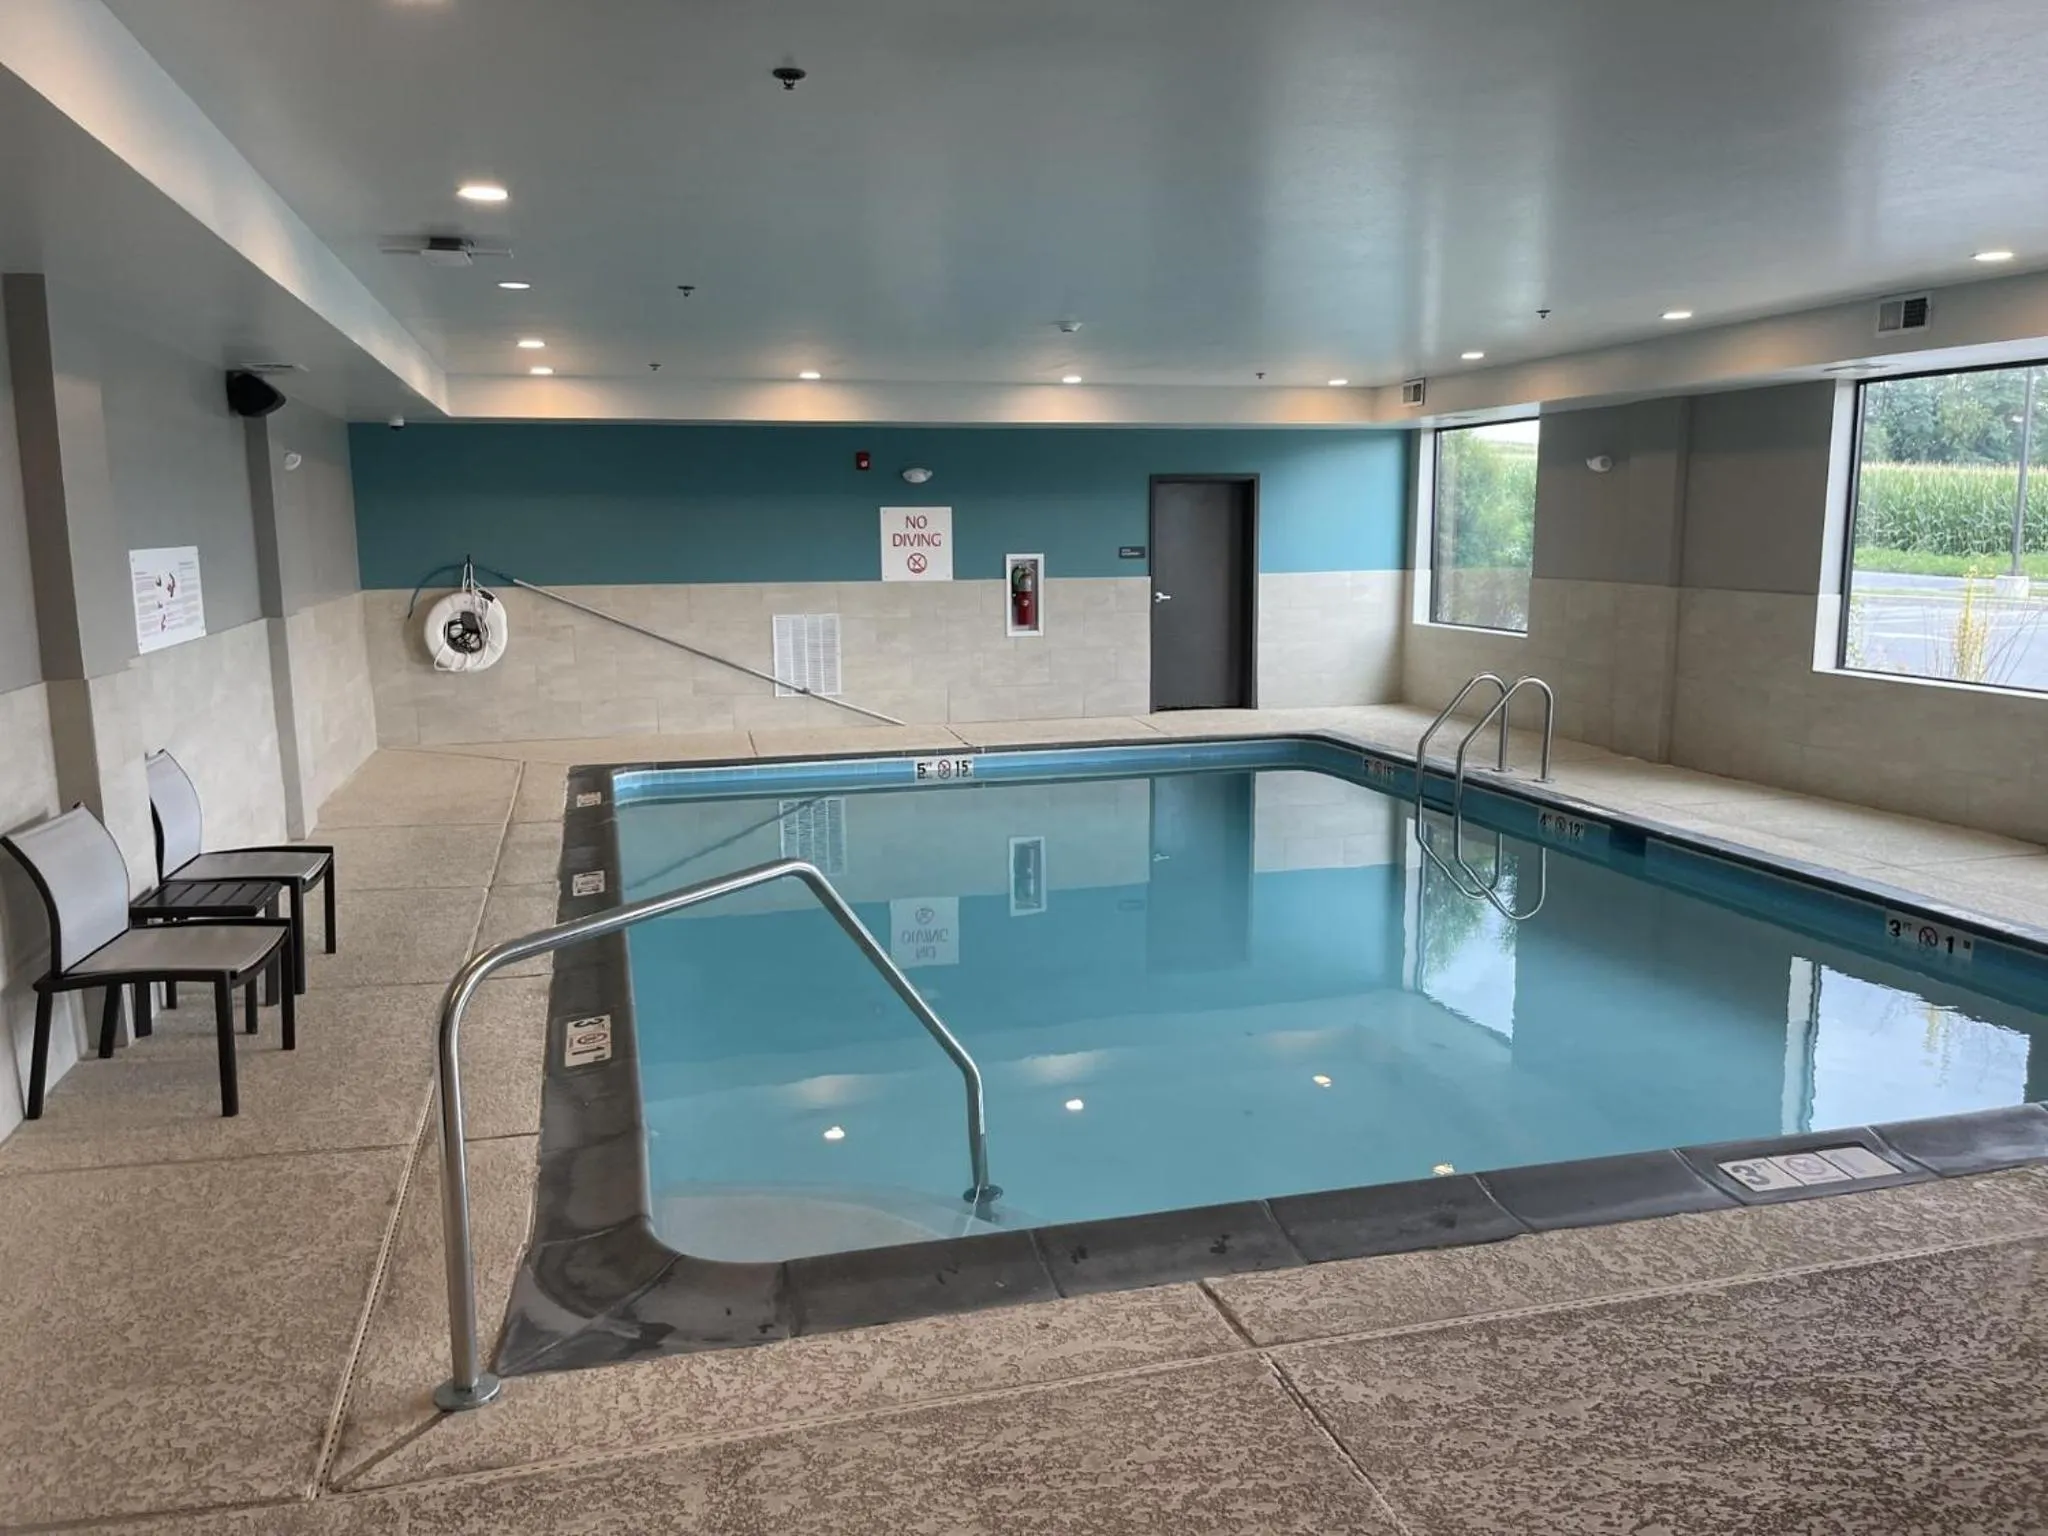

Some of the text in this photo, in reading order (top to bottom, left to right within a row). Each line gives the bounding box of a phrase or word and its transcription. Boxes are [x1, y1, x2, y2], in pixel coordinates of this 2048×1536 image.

[905, 514, 928, 529] NO
[892, 532, 942, 547] DIVING
[1889, 919, 1901, 937] 3
[1731, 1164, 1771, 1186] 3
